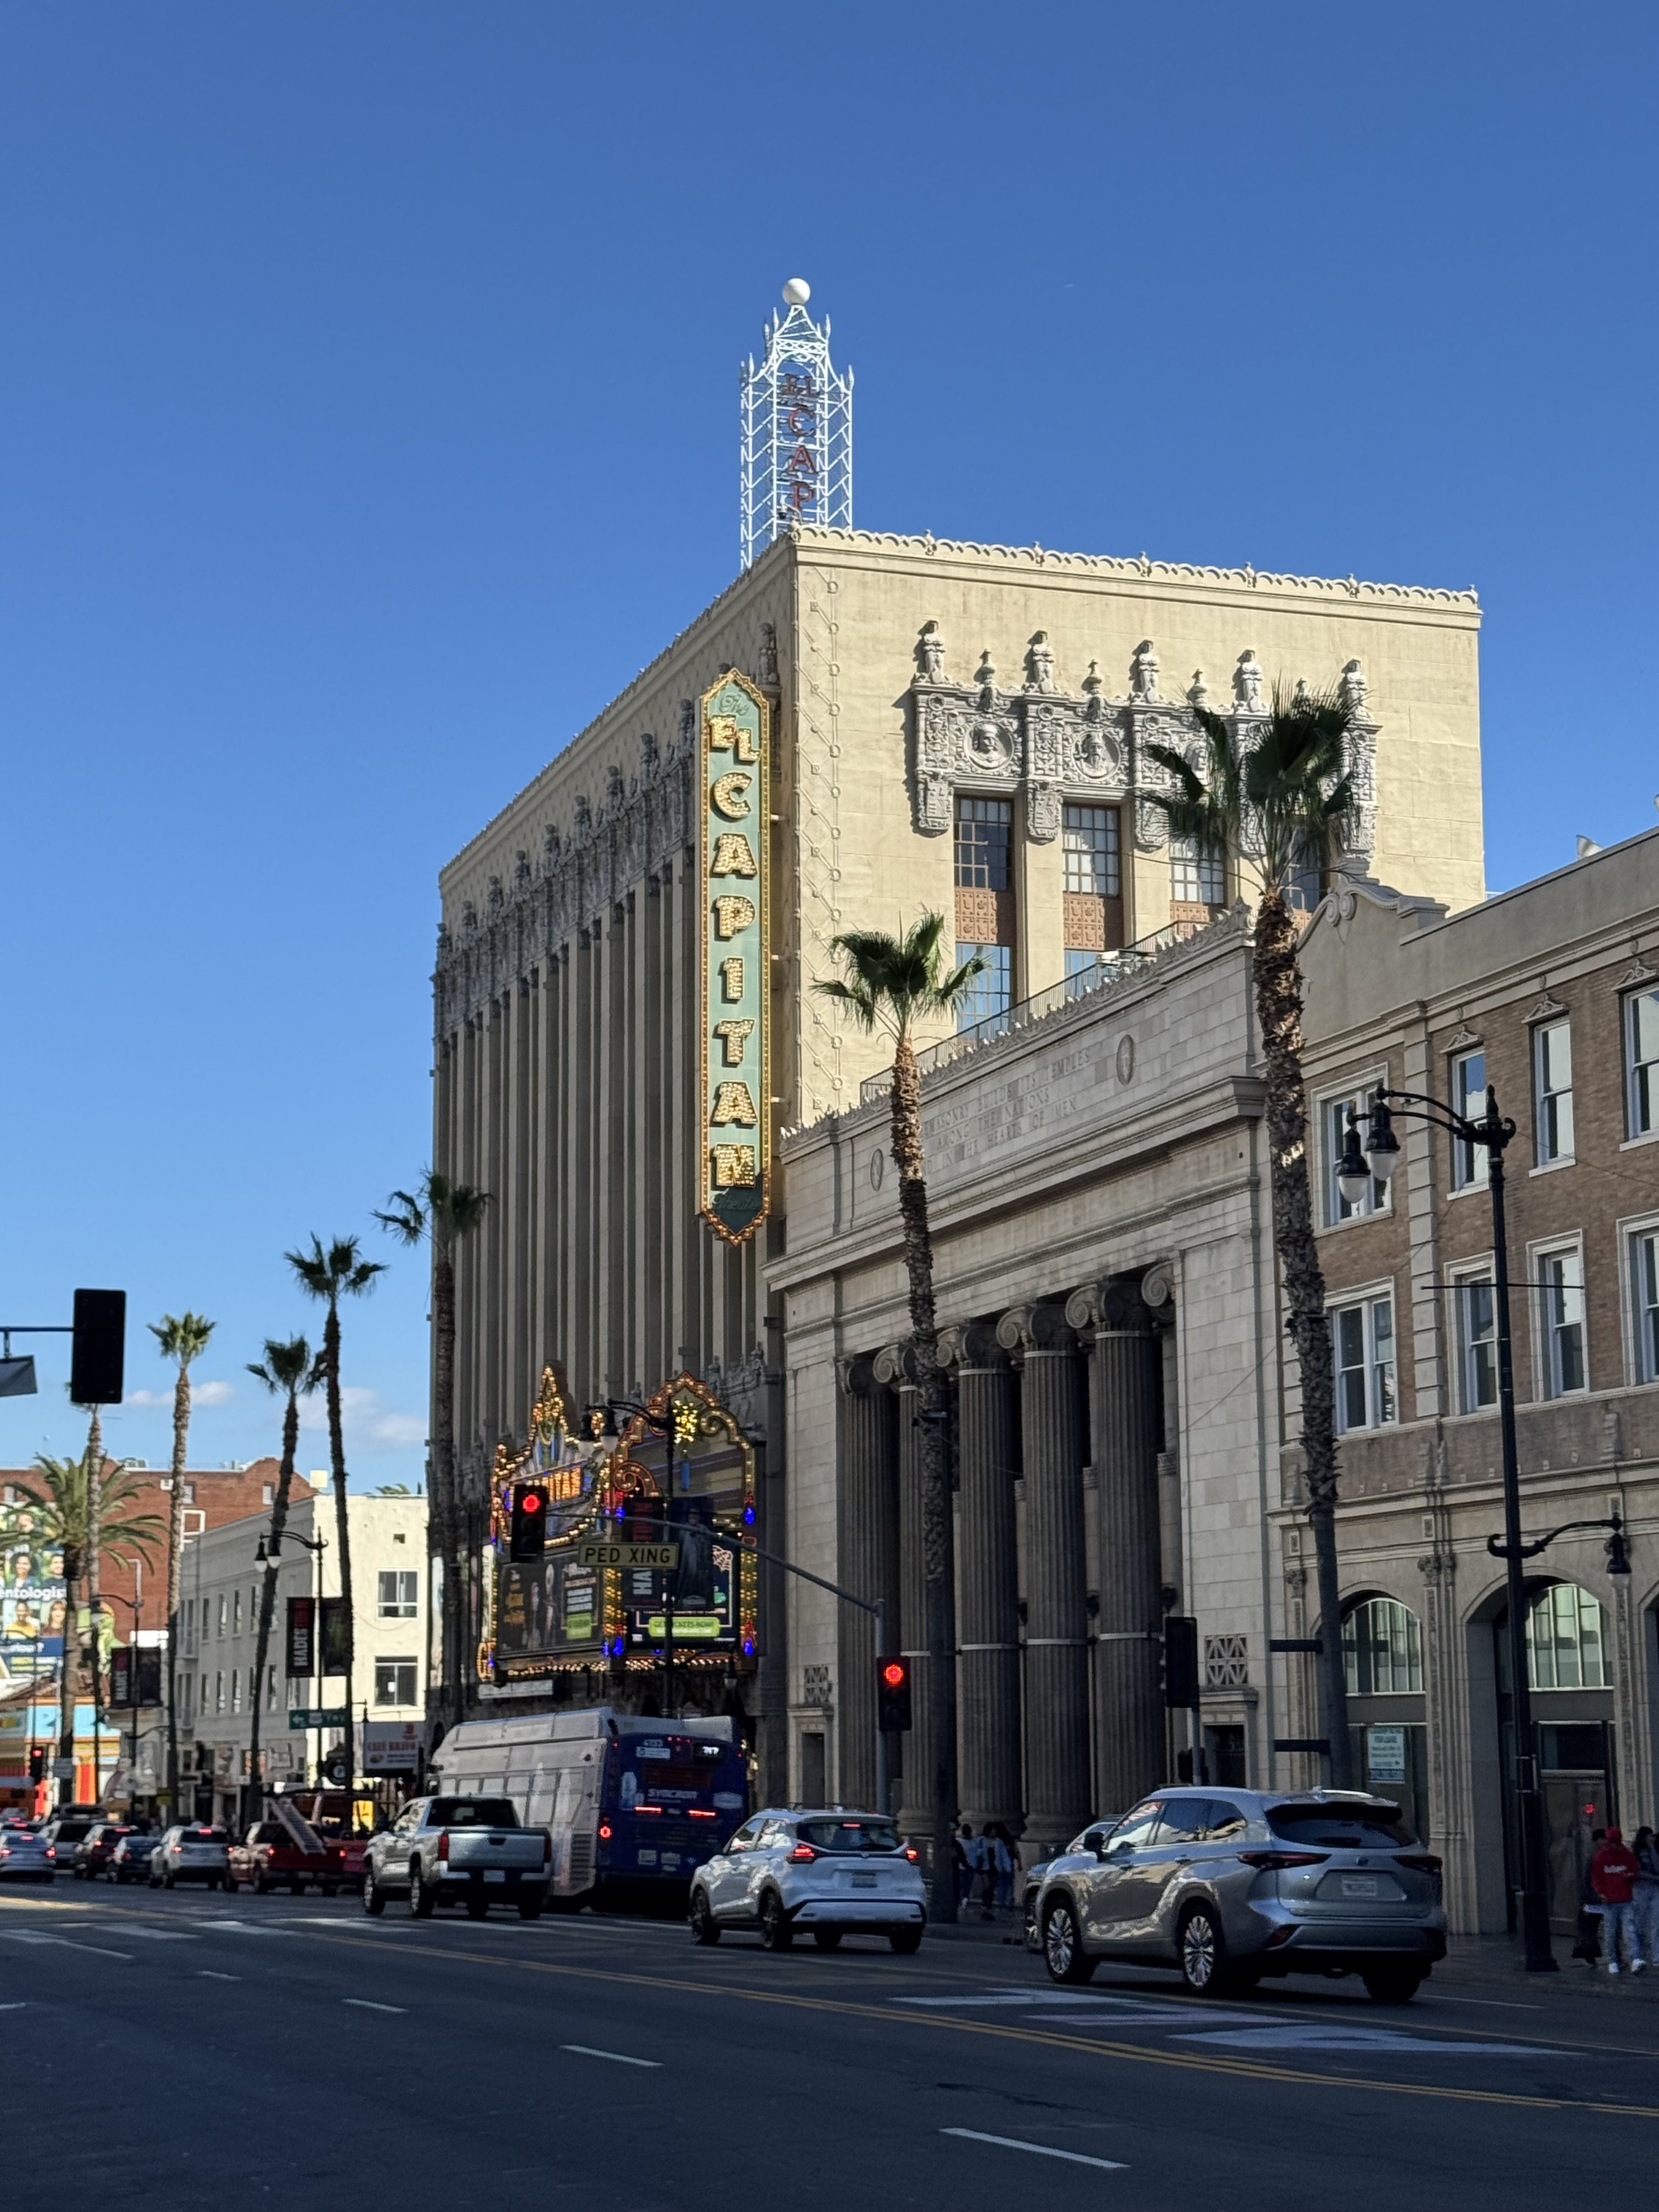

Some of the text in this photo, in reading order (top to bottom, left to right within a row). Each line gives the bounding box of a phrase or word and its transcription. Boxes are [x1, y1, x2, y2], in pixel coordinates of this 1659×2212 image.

[785, 373, 820, 397] EL
[719, 692, 749, 716] The
[710, 714, 761, 763] EL
[713, 771, 758, 1188] CAPITAN
[1018, 1073, 1036, 1094] ITS
[1046, 1049, 1090, 1081] TEMPLES
[938, 1087, 1049, 1151] AMONG THE NATIONS
[987, 1121, 1022, 1149] HEARTS
[1032, 1110, 1045, 1130] OF
[1054, 1096, 1077, 1118] MEN
[585, 1547, 670, 1564] PED XING
